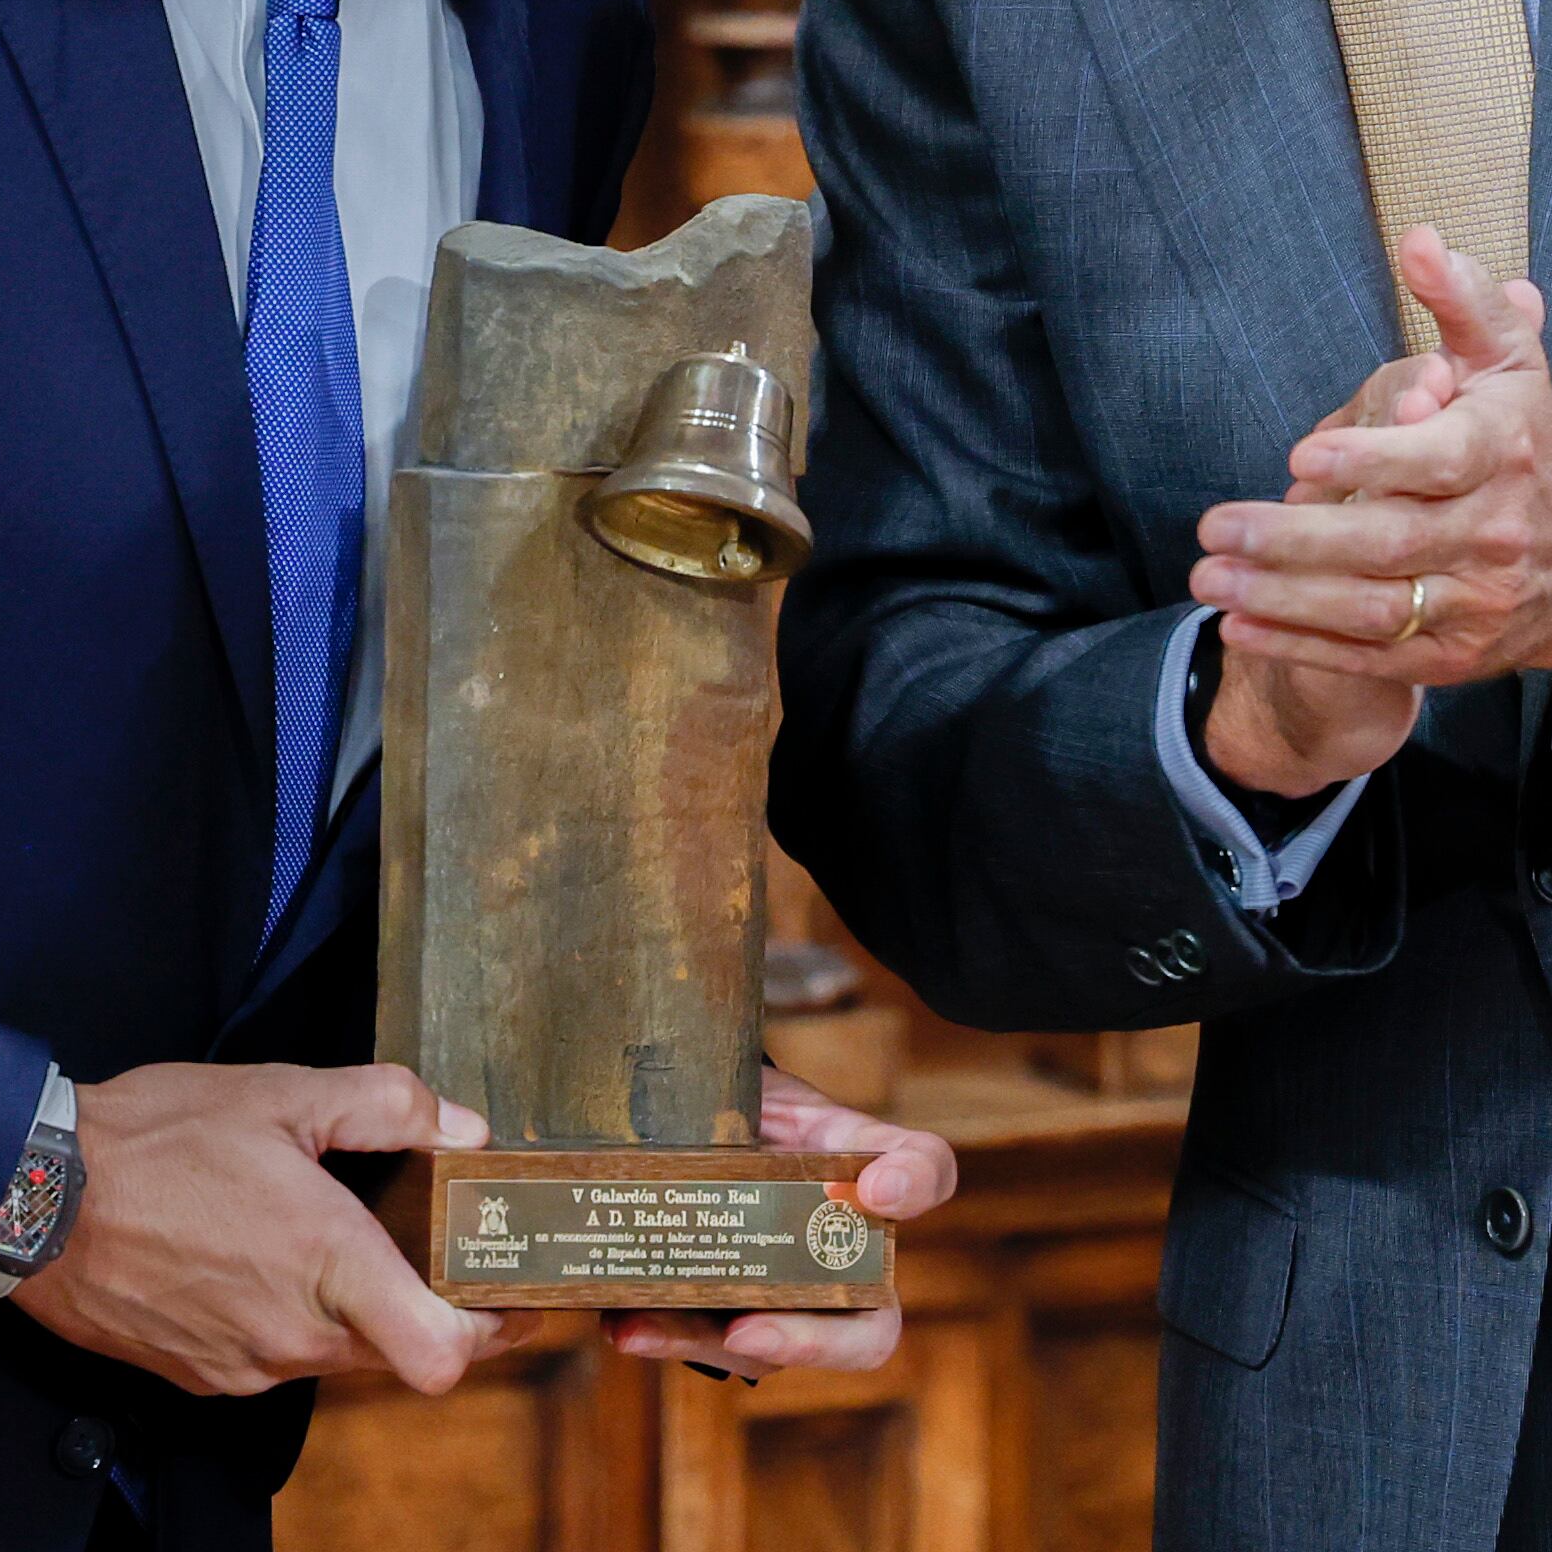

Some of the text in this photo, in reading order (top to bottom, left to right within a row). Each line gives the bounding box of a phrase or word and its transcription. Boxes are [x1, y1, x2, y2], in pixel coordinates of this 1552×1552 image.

[572, 1188, 760, 1205] V Galardón Camino Real
[586, 1210, 745, 1227] A D. Rafael Nadal
[457, 1234, 529, 1251] Universidad
[535, 1232, 795, 1247] en reconocimiento a su labor en la divulgación
[465, 1251, 520, 1268] de Alcalá
[589, 1247, 741, 1262] de España en Norteamérica
[561, 1263, 768, 1278] Alcalá de Henares, 20 de septiembre de 2022
